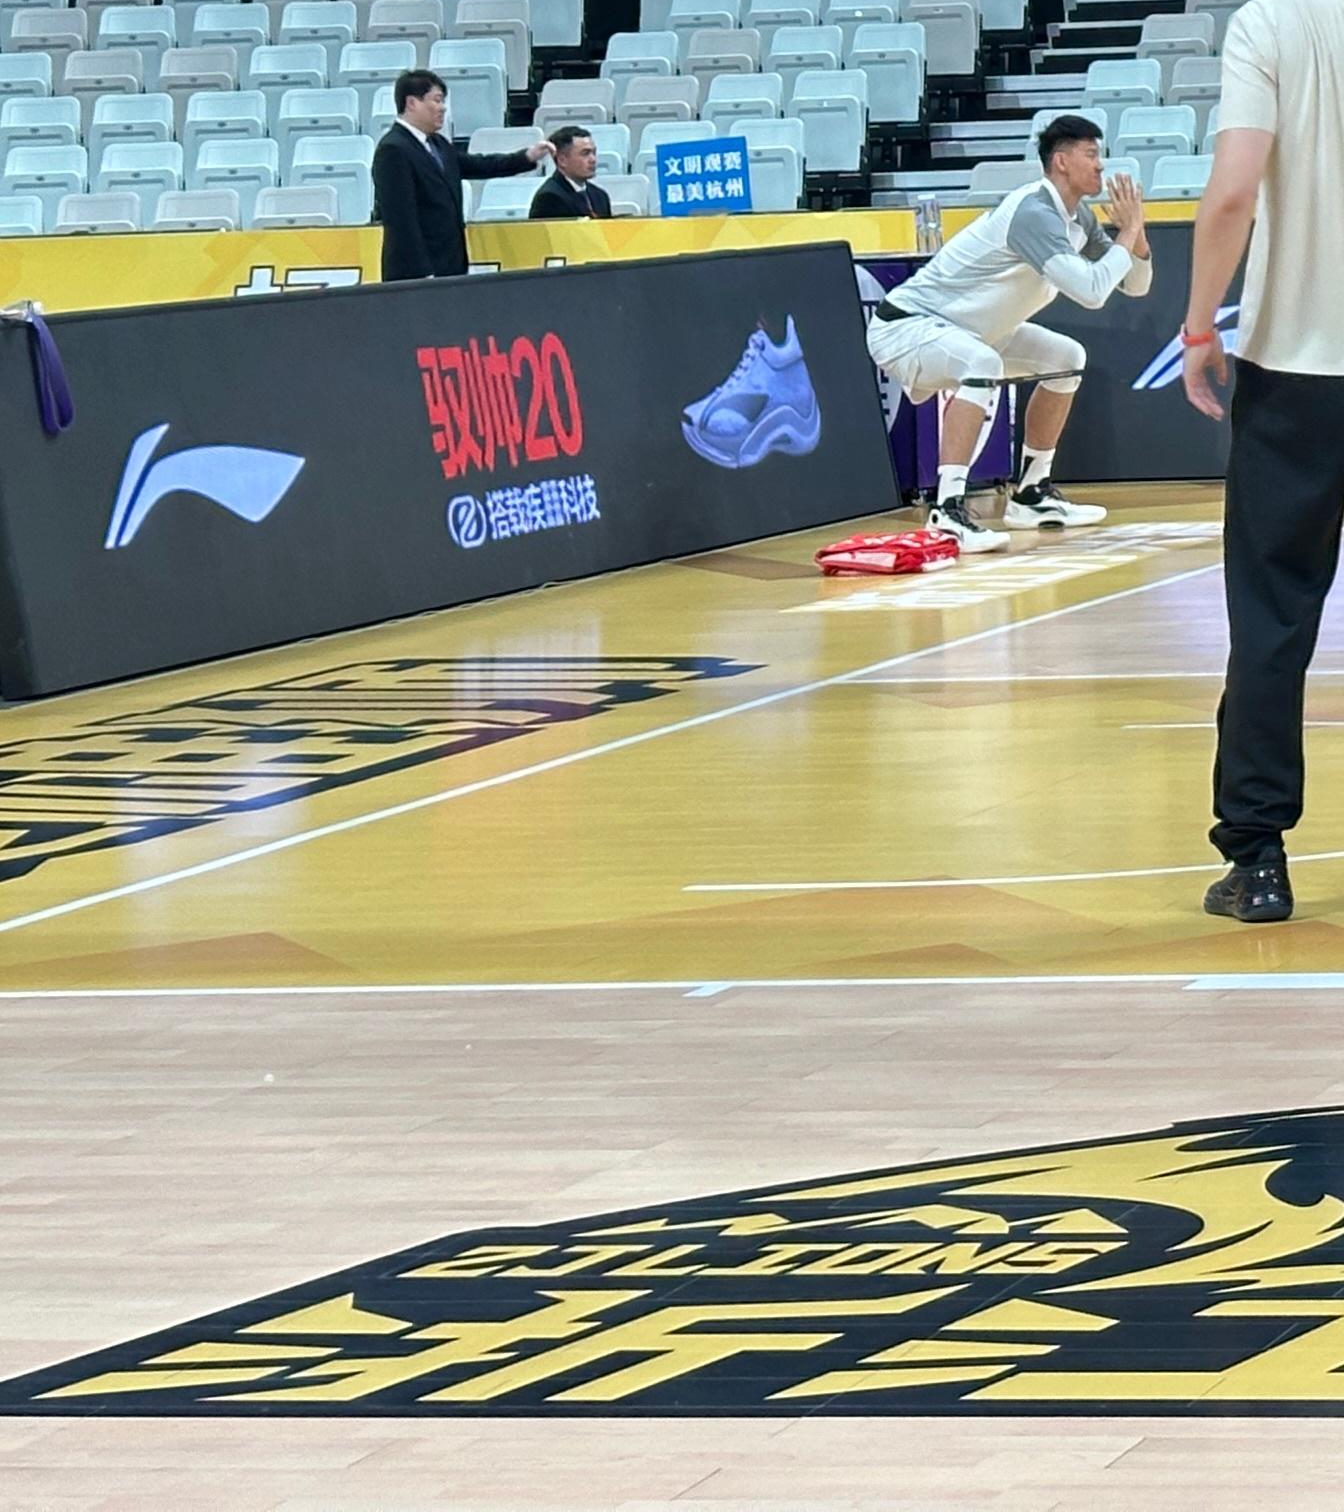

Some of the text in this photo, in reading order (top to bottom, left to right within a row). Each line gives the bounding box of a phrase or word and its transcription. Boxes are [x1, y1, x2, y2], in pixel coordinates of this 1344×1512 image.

[664, 151, 742, 178] 文明观赛
[666, 177, 744, 204] 最美杭州
[416, 332, 583, 479] 驭帅20
